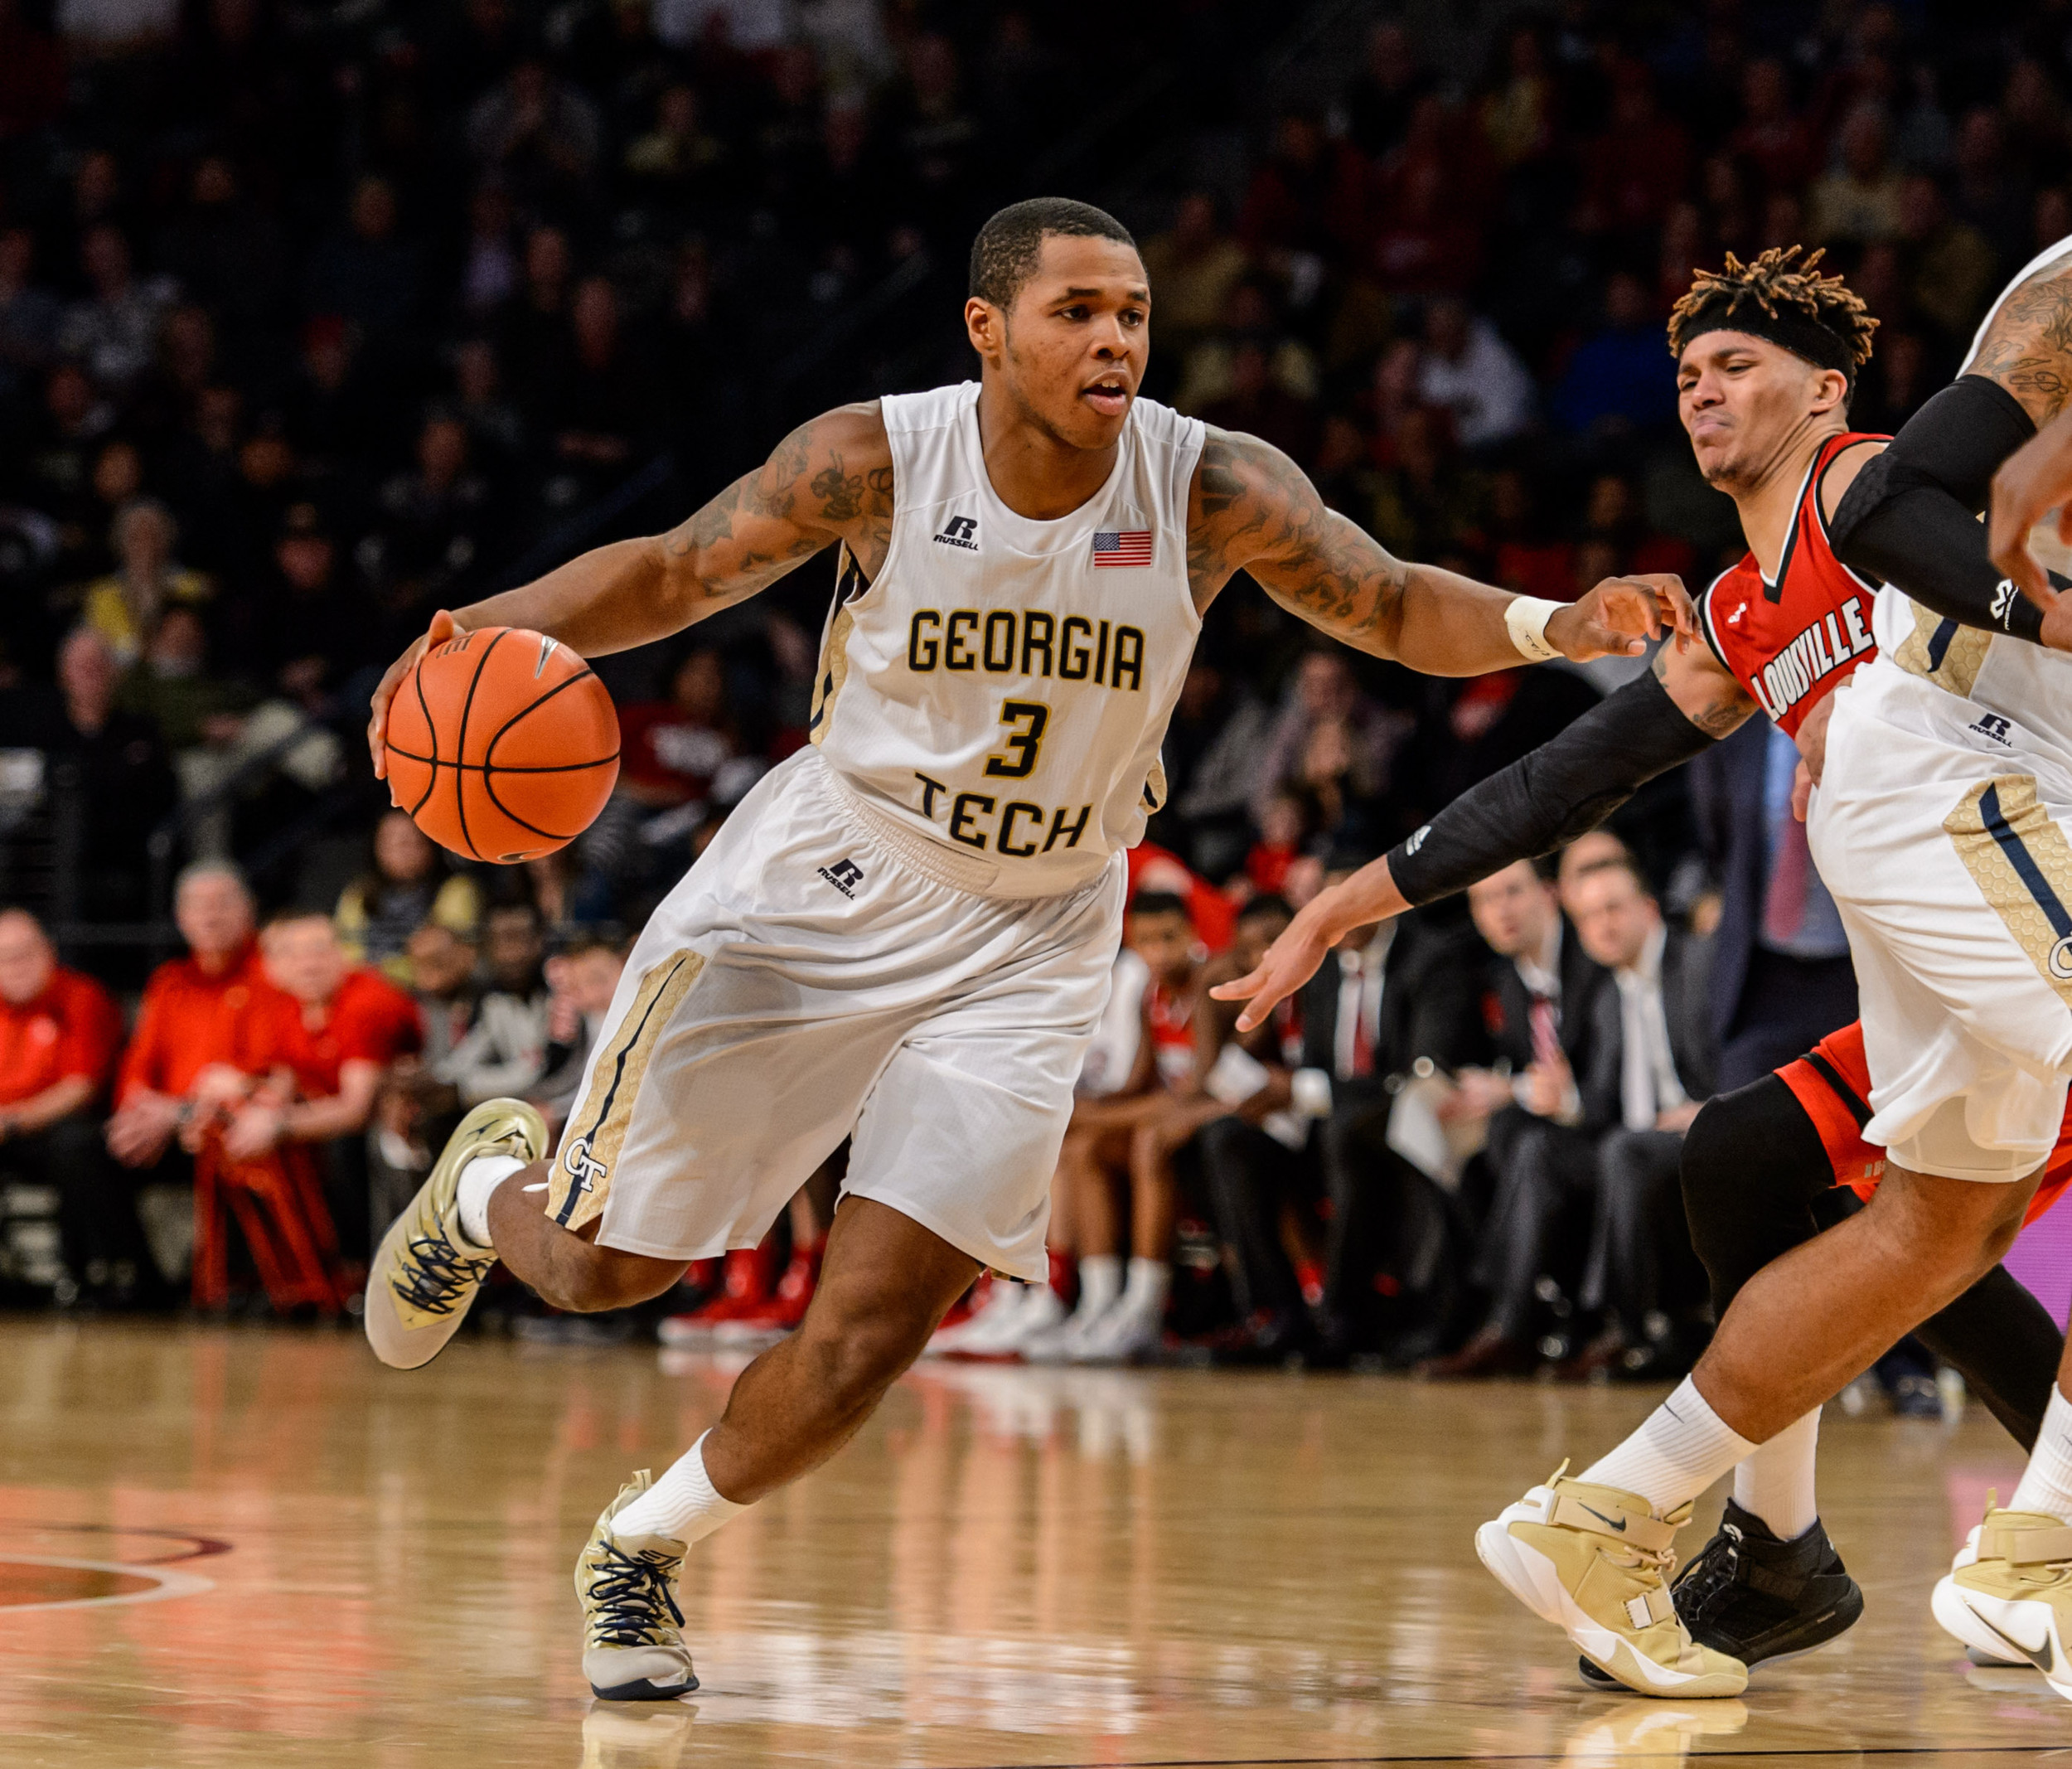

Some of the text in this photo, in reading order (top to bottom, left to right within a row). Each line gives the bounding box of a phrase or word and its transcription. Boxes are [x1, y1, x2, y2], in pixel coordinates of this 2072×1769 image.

[933, 534, 978, 550] RUSSELL
[908, 608, 1145, 691] GEORGIA
[1750, 595, 1875, 723] LOUISVILLE
[981, 698, 1052, 780] 3
[1968, 724, 2011, 748] RUSSELL
[914, 771, 1094, 858] TECH
[817, 866, 855, 900] RUSSELL
[564, 1137, 608, 1193] GT
